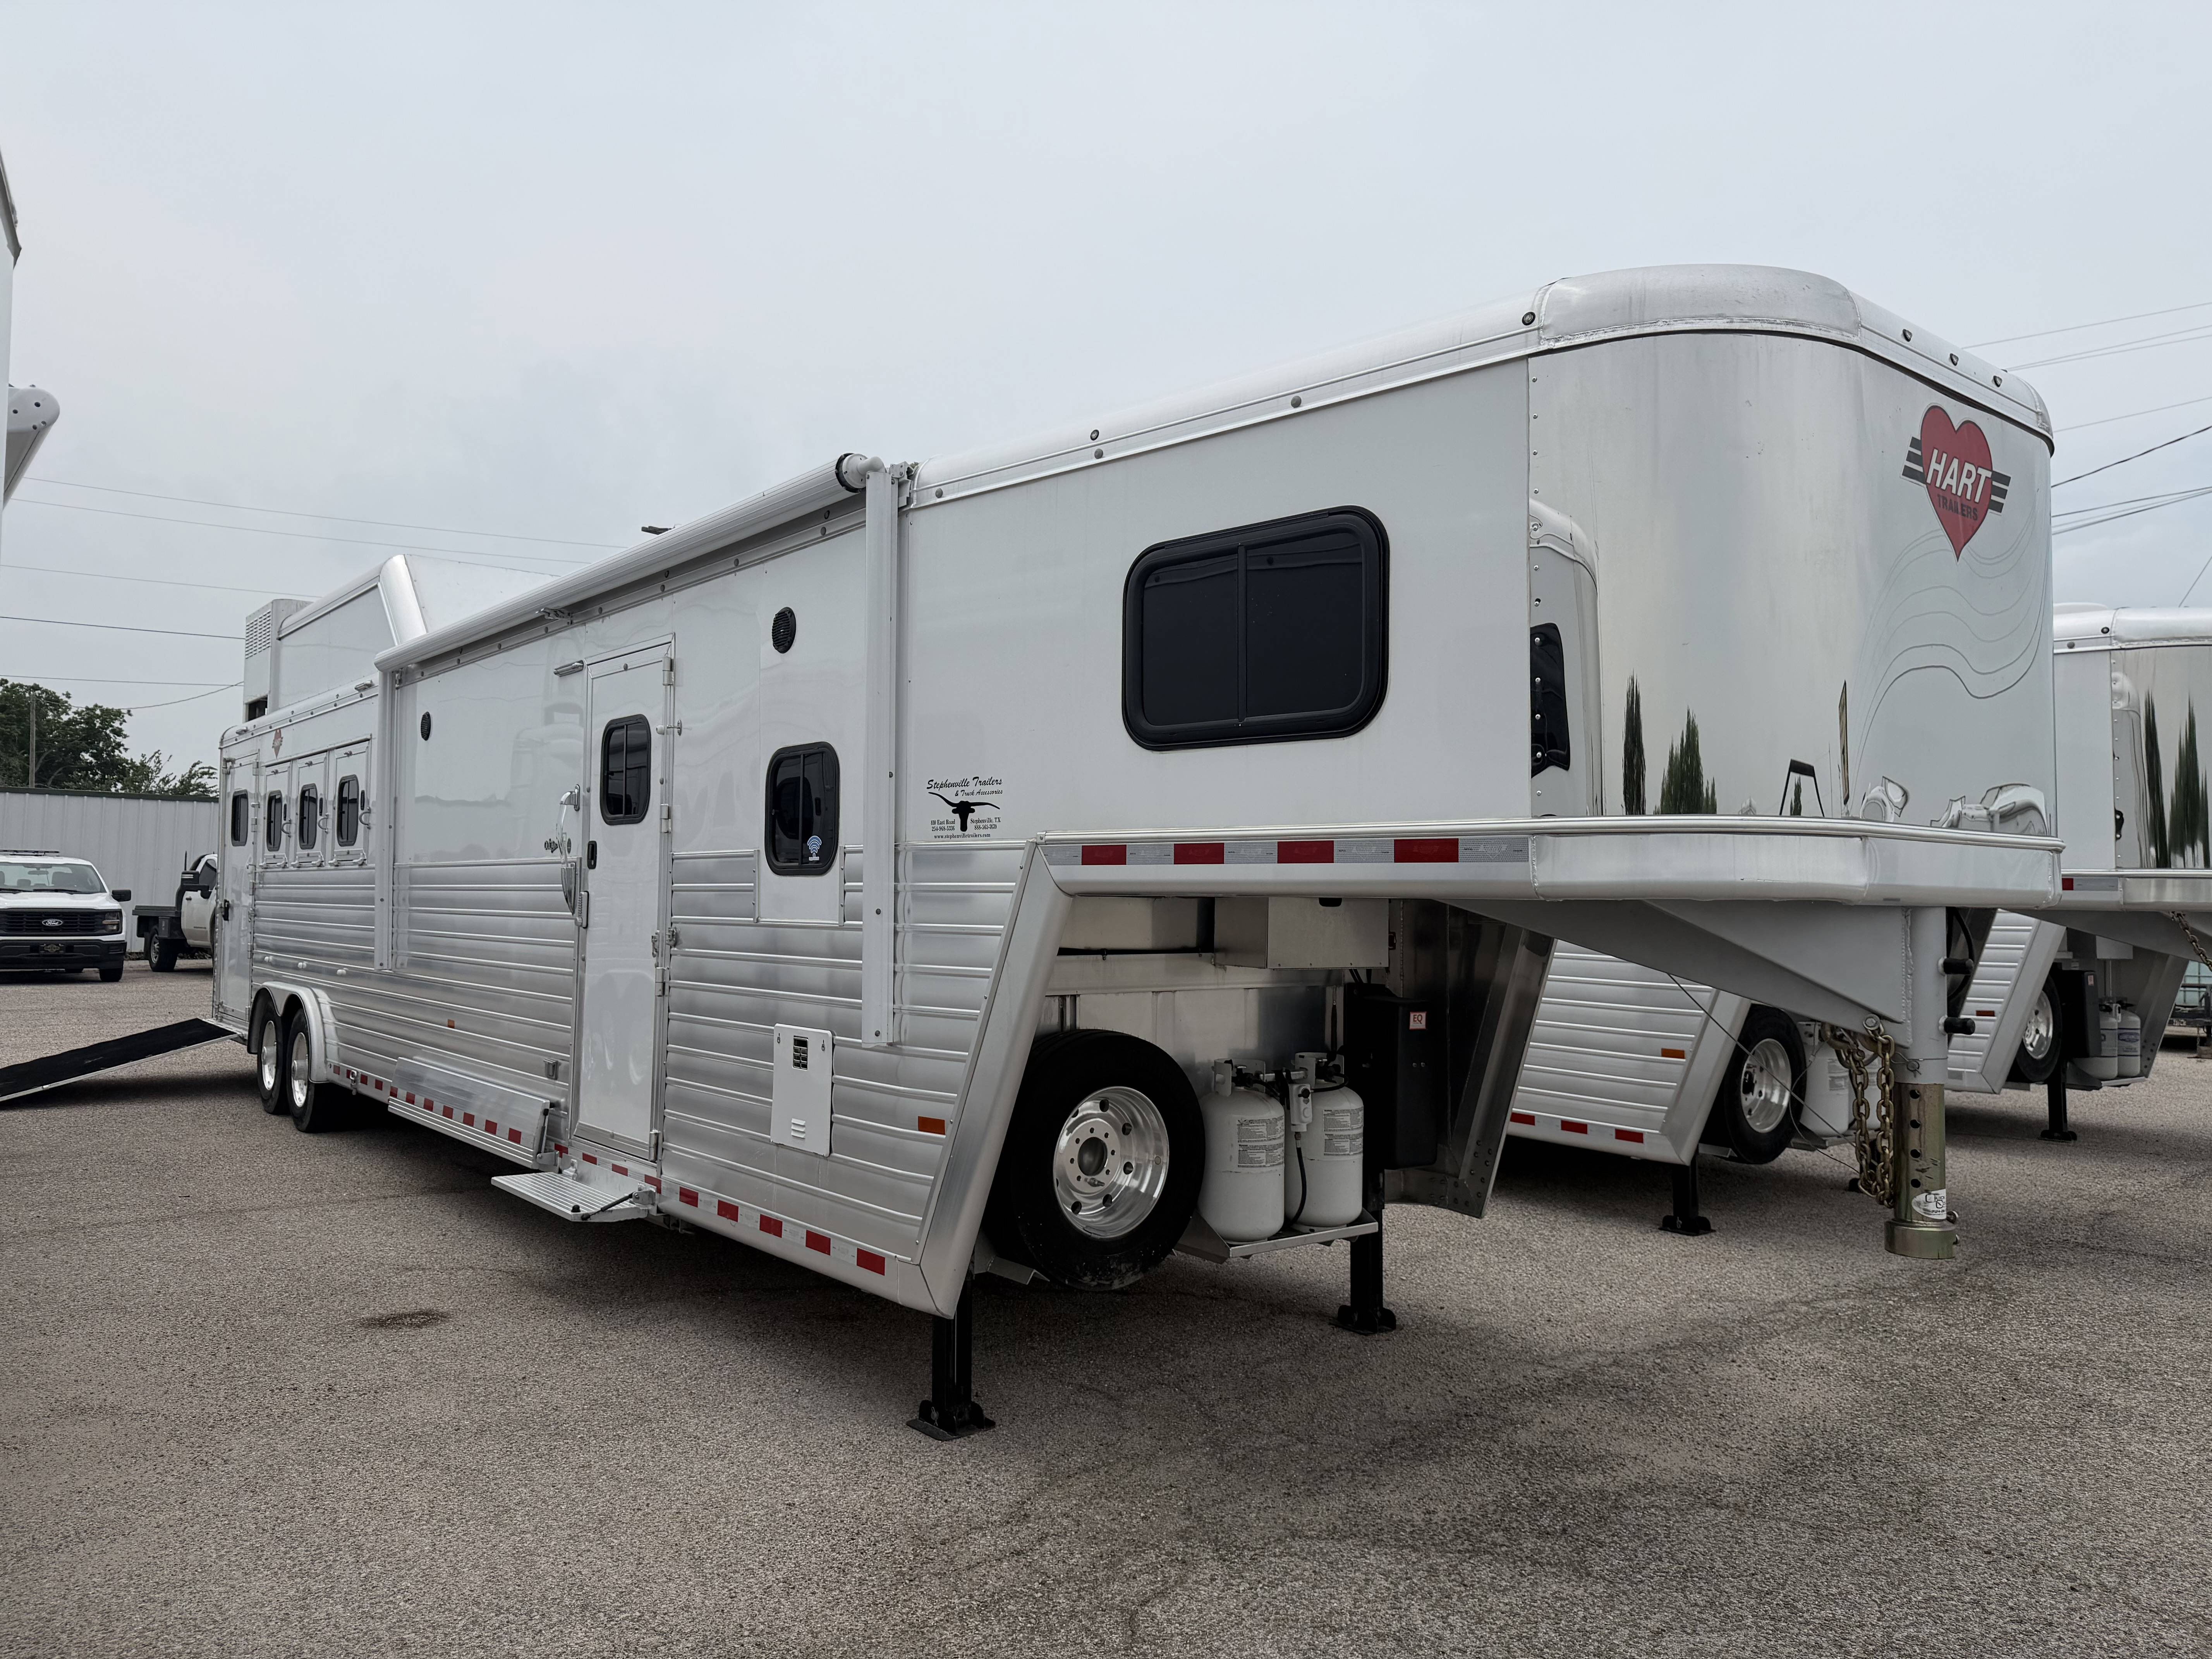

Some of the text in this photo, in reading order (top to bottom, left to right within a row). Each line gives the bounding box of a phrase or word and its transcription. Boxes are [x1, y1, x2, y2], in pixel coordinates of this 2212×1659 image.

[1926, 448, 1992, 503] HART
[1937, 494, 1978, 521] TRAILERS
[927, 776, 1003, 791] Stephenville Trailers
[1413, 1014, 1422, 1024] EQ
